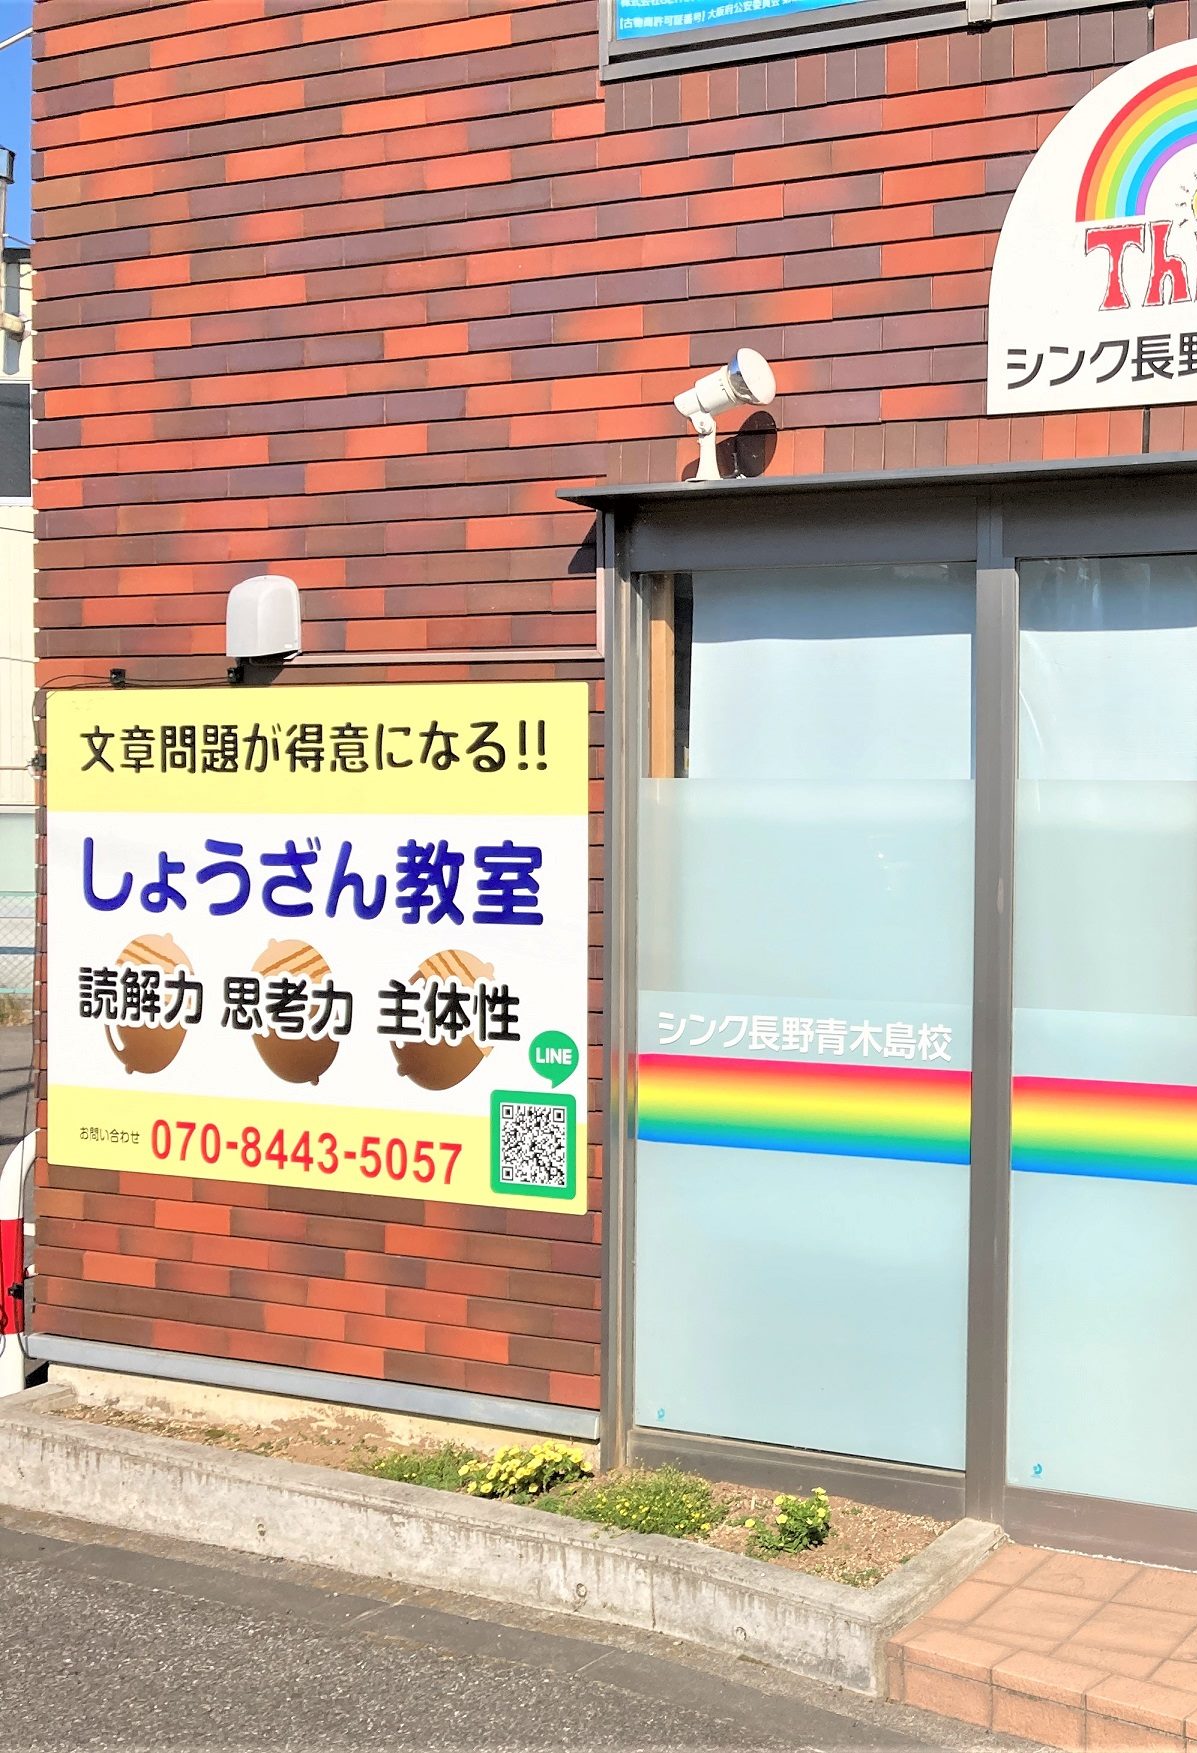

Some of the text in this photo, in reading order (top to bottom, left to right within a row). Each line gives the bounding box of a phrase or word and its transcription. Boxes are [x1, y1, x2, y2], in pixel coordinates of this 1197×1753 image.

[83, 836, 544, 926] しょうざん教室
[78, 966, 521, 1042] 読解力 思考力 主体性
[658, 1011, 952, 1063] シンク長野青木島校
[535, 1046, 572, 1065] LINE
[79, 1119, 463, 1185] お問い合わせ 070-8443-5057
